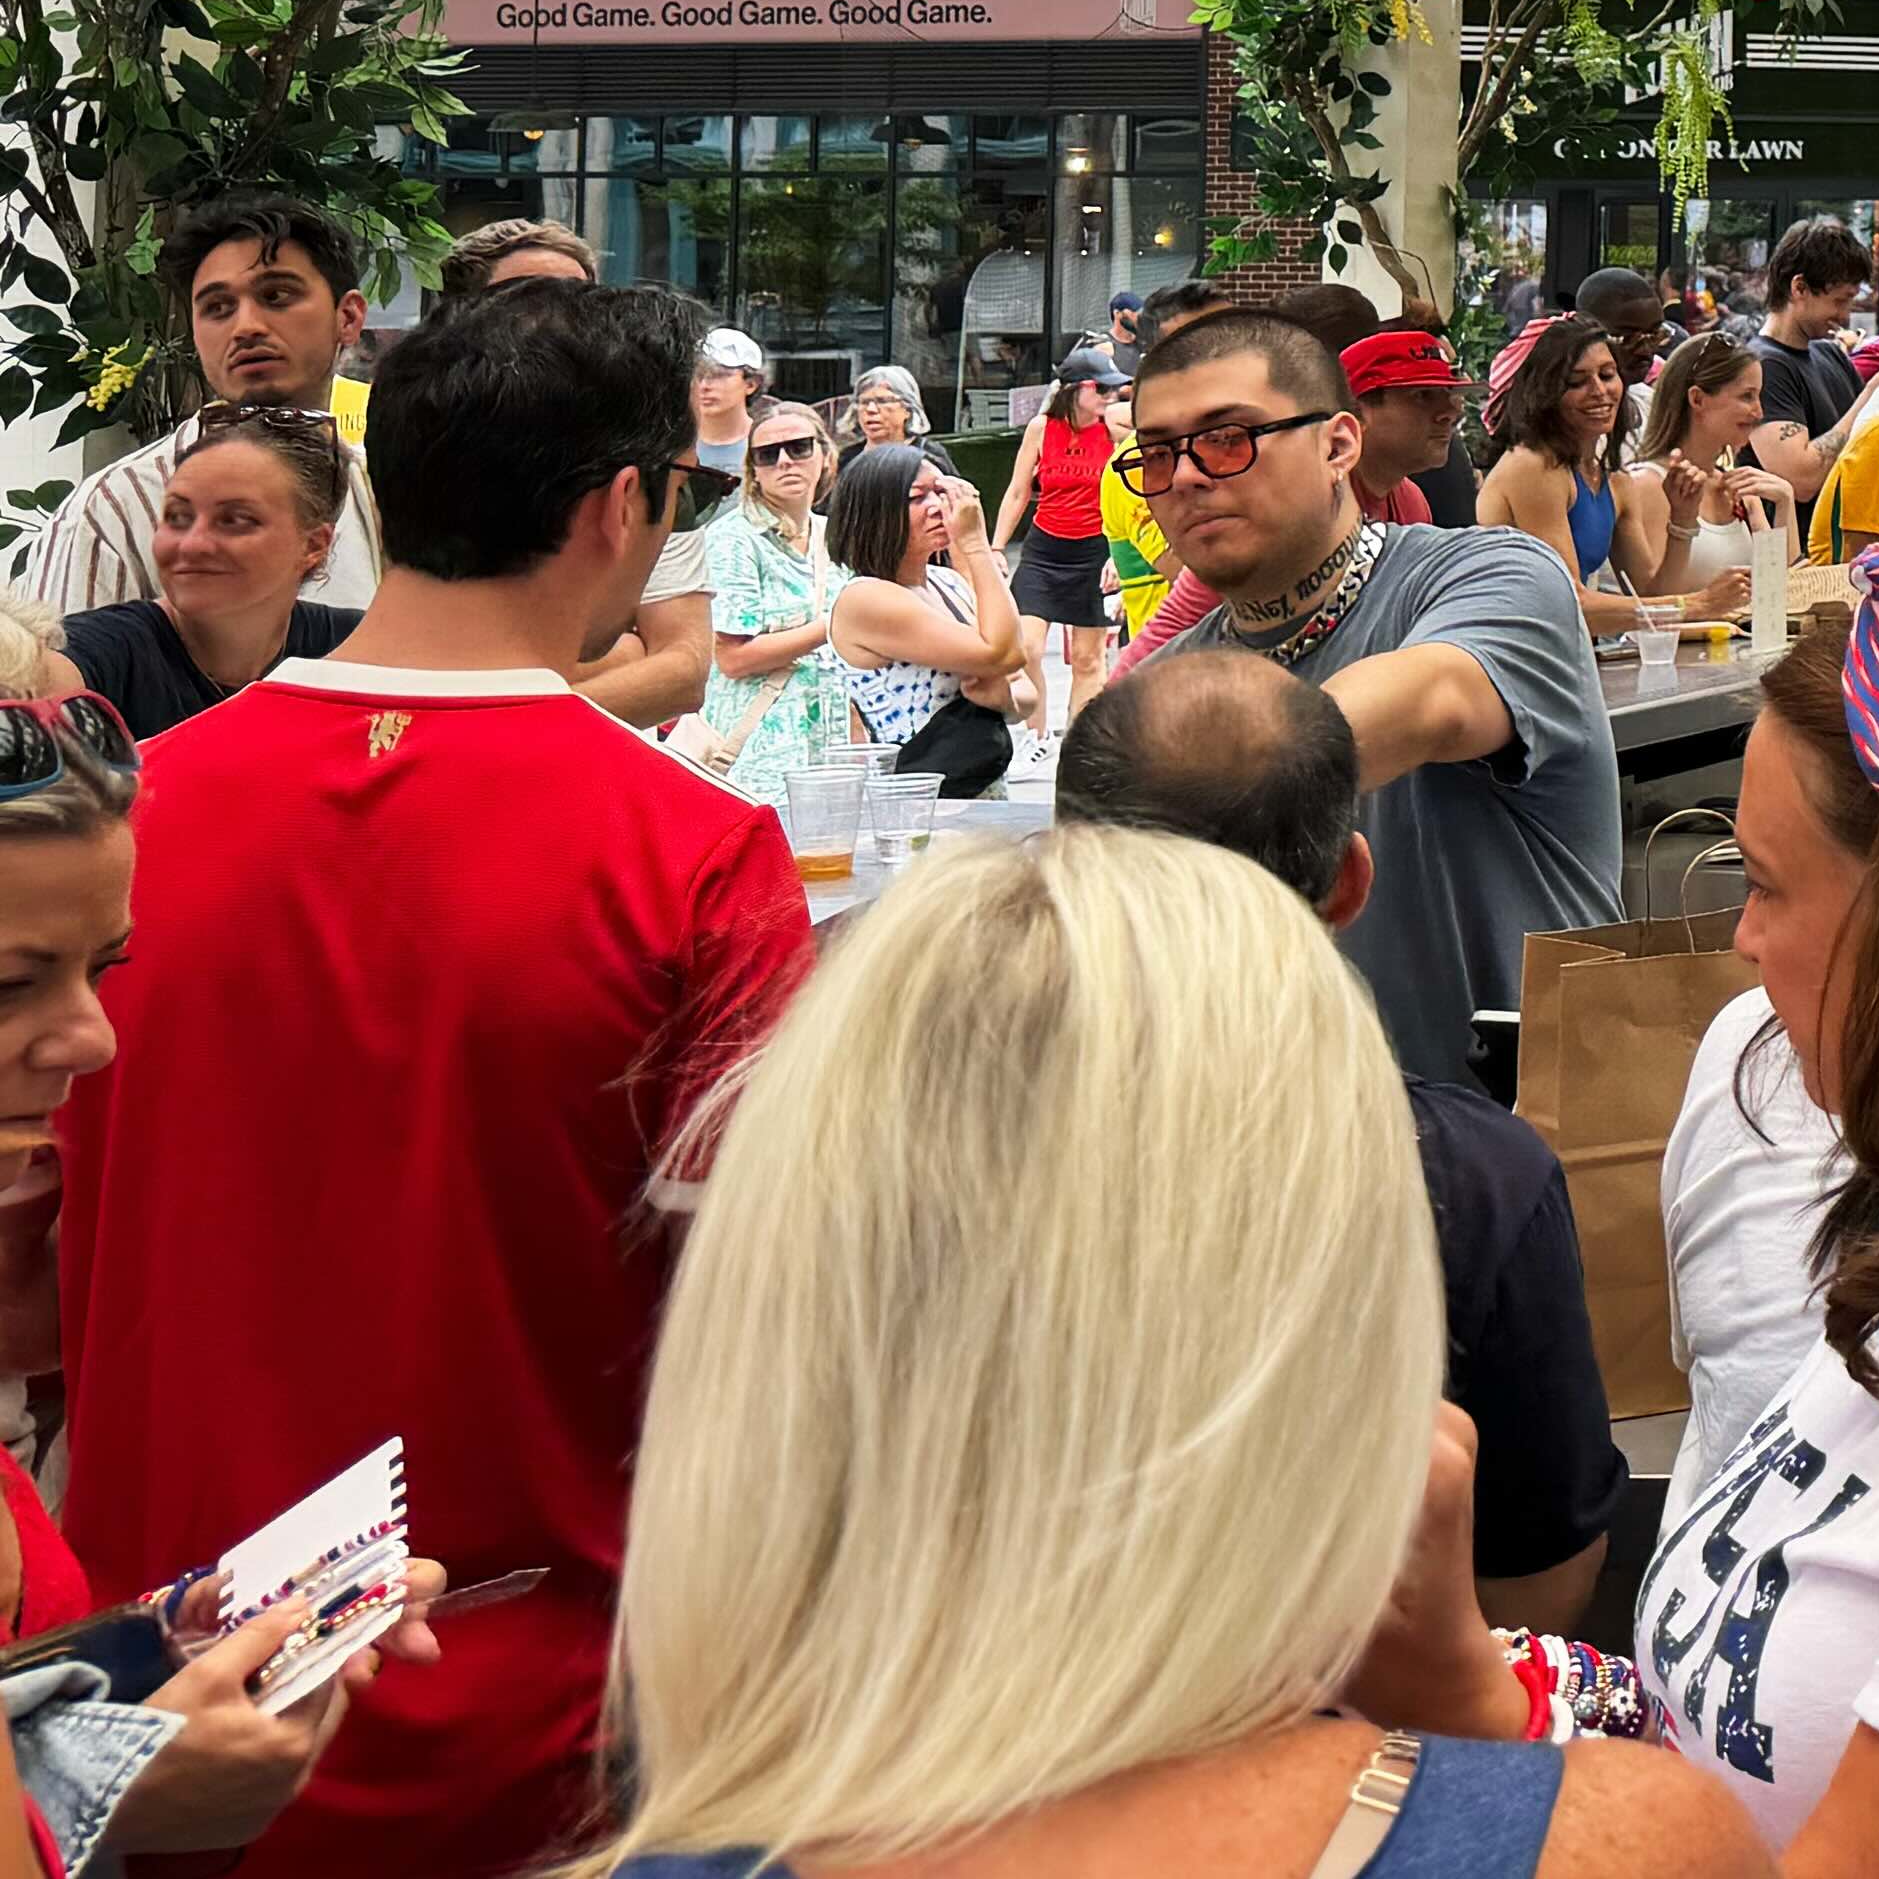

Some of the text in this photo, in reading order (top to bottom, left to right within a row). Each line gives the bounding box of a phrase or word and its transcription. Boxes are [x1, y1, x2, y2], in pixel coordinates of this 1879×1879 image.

[497, 0, 993, 28] Good Game. Good Game. Good Game.
[1730, 140, 1803, 159] LAWN
